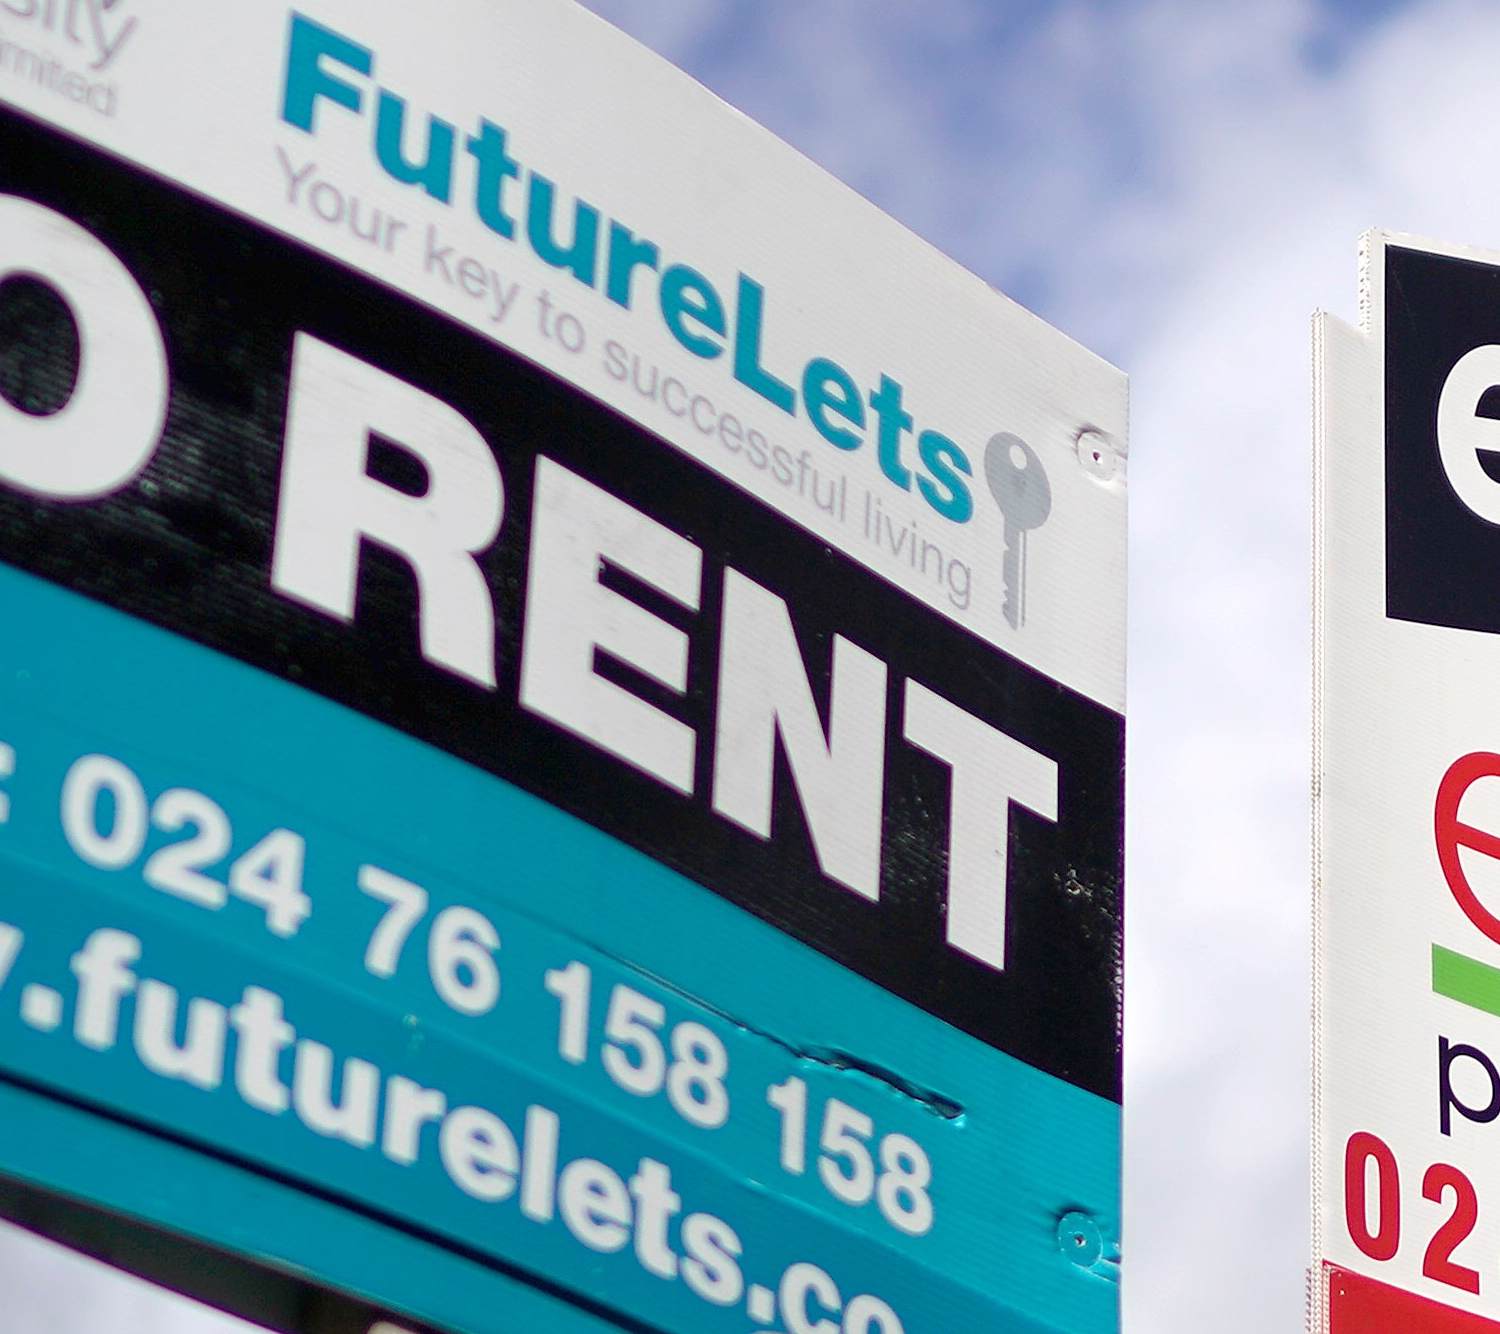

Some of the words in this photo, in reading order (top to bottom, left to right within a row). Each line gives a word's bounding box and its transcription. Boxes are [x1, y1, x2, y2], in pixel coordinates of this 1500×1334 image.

[273, 145, 406, 256] Your
[423, 223, 523, 322] key
[537, 287, 586, 356] to
[603, 334, 847, 514] successful
[862, 490, 973, 612] living
[279, 8, 975, 526] FutureLets
[270, 332, 1058, 972] RENT
[60, 753, 310, 938] 024
[357, 863, 500, 1016] 76
[543, 958, 729, 1128] 158
[766, 1078, 934, 1235] 158
